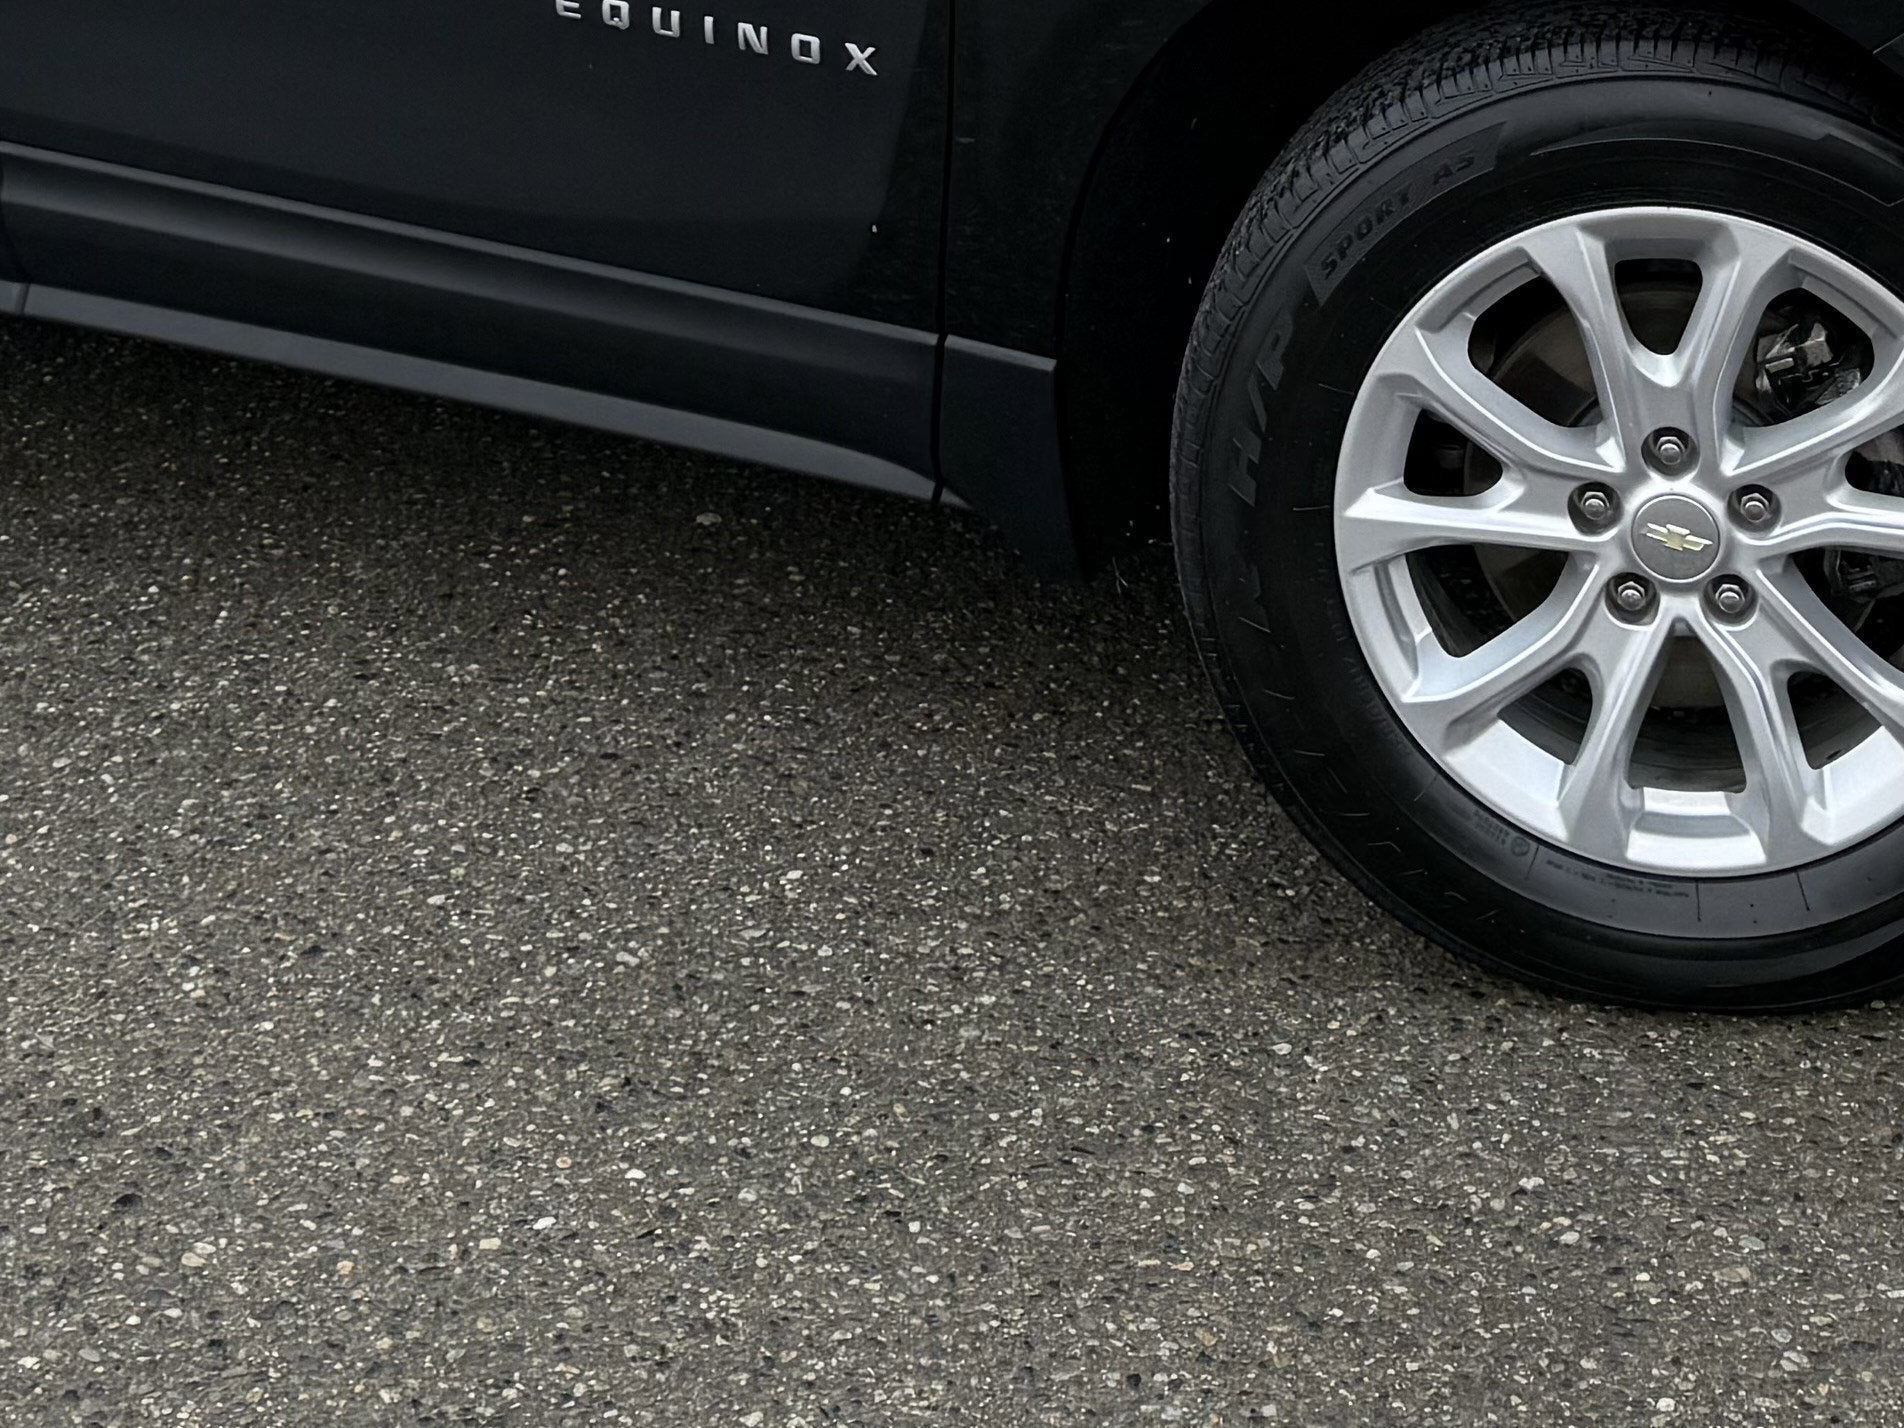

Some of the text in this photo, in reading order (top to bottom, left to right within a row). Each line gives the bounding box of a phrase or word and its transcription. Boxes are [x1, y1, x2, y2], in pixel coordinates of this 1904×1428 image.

[1227, 149, 1478, 507] H/P SPORT AS
